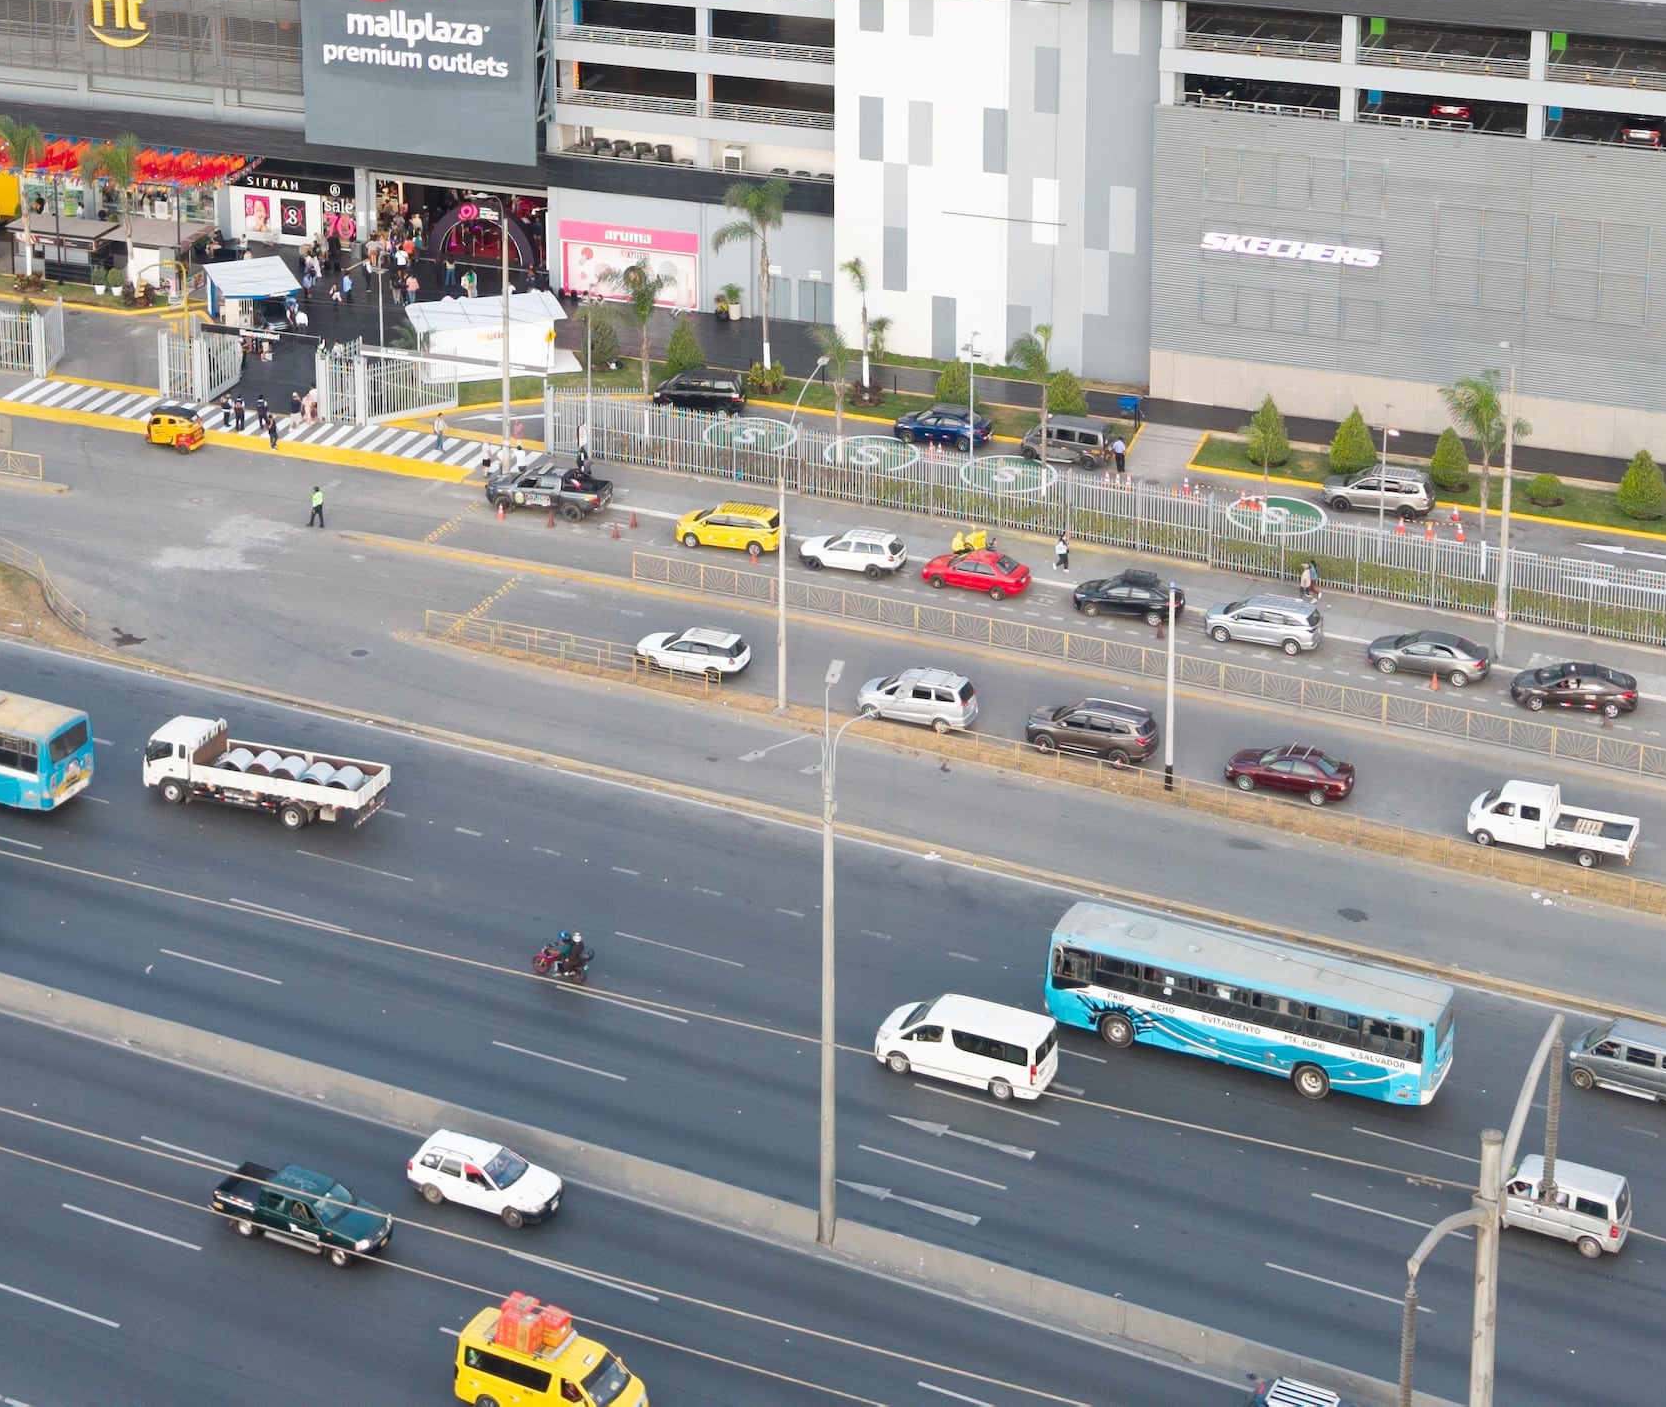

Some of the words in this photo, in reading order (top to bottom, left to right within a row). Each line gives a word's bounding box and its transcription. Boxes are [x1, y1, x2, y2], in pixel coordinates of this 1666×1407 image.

[346, 10, 484, 48] mallplaza
[322, 42, 423, 72] premium
[428, 50, 509, 79] outlets
[247, 176, 299, 191] SIFRAH
[324, 199, 354, 214] sale
[604, 230, 652, 244] aruma
[1200, 231, 1383, 269] SKECHERS
[1107, 992, 1125, 1002] PRO
[1150, 1002, 1175, 1014] ACHO
[1201, 1014, 1261, 1035] EVITAMIENTO
